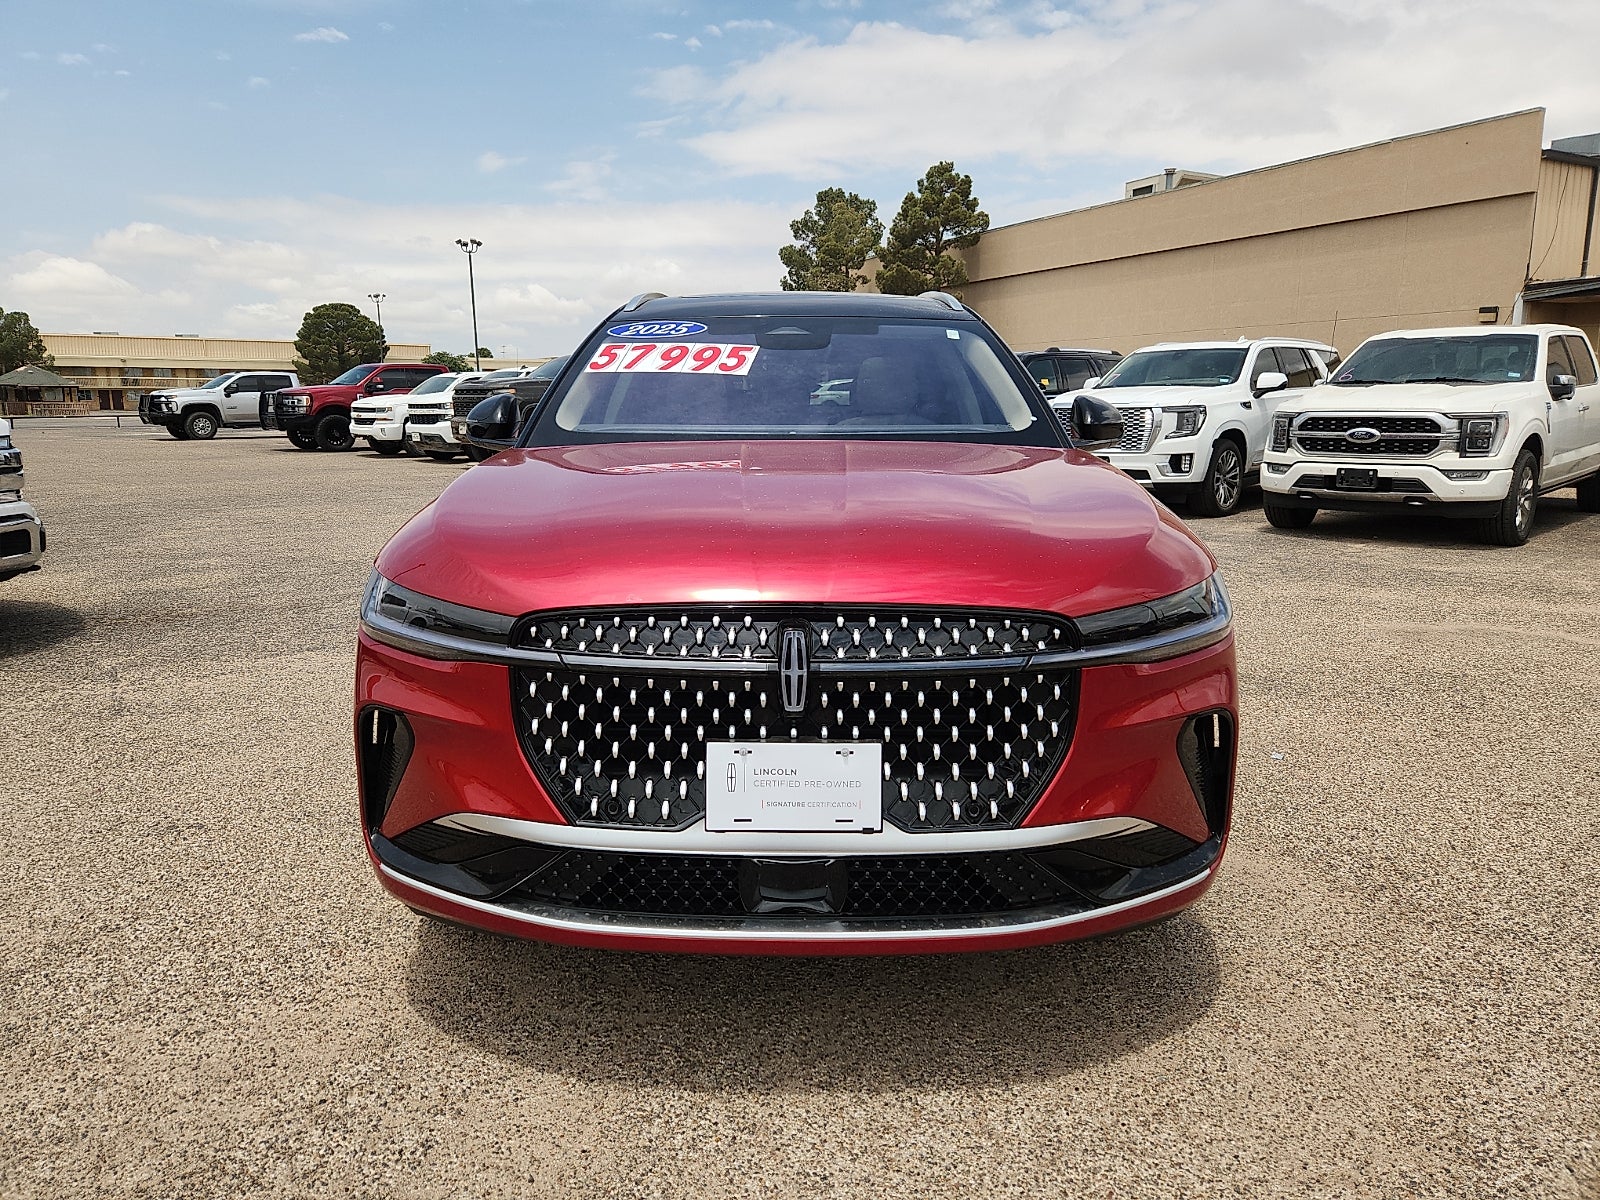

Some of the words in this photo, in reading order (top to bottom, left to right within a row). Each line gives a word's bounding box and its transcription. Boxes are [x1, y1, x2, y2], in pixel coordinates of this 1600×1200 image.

[621, 323, 694, 336] 2025
[589, 344, 755, 372] 57995
[753, 768, 797, 776] LINCOLN
[753, 780, 801, 788] CERTIFIED
[804, 780, 862, 788] PRE-OWNED
